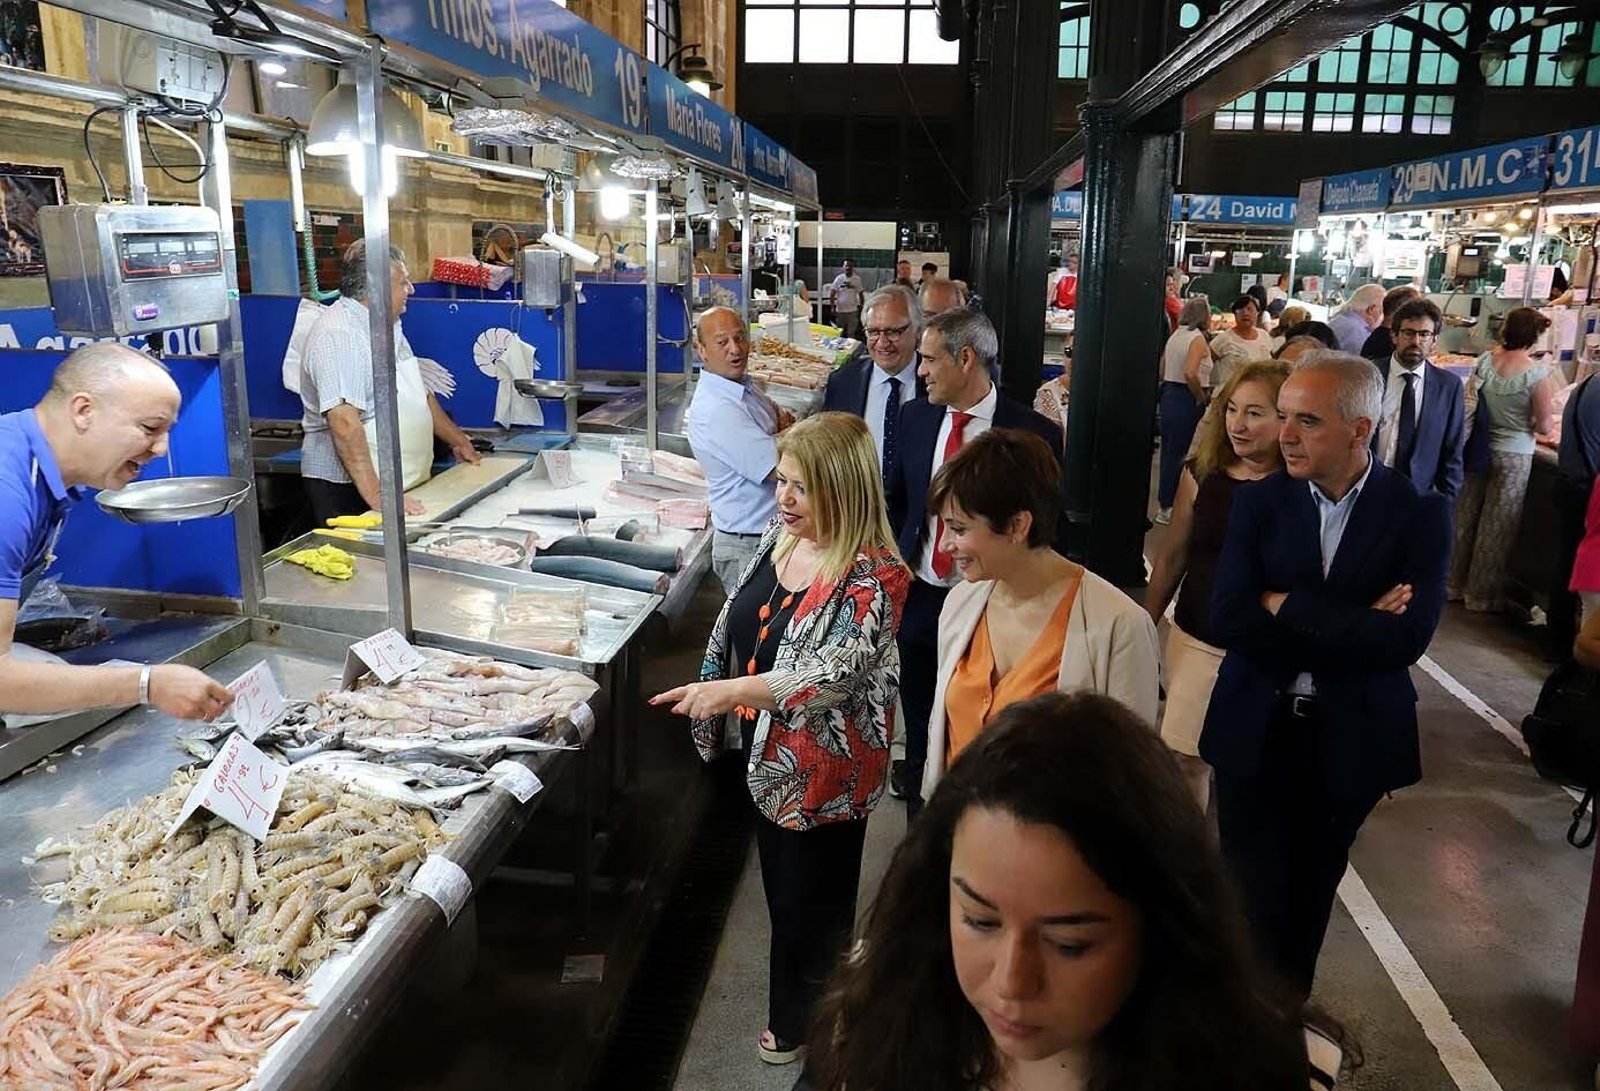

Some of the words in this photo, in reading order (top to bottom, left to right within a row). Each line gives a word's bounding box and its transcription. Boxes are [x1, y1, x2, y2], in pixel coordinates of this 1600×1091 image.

[509, 0, 593, 98] Agarrado
[614, 47, 641, 129] 19
[695, 102, 722, 154] Flores
[1393, 164, 1415, 204] 29
[1554, 130, 1592, 186] 31
[1189, 195, 1222, 220] 24
[1231, 201, 1284, 218] David
